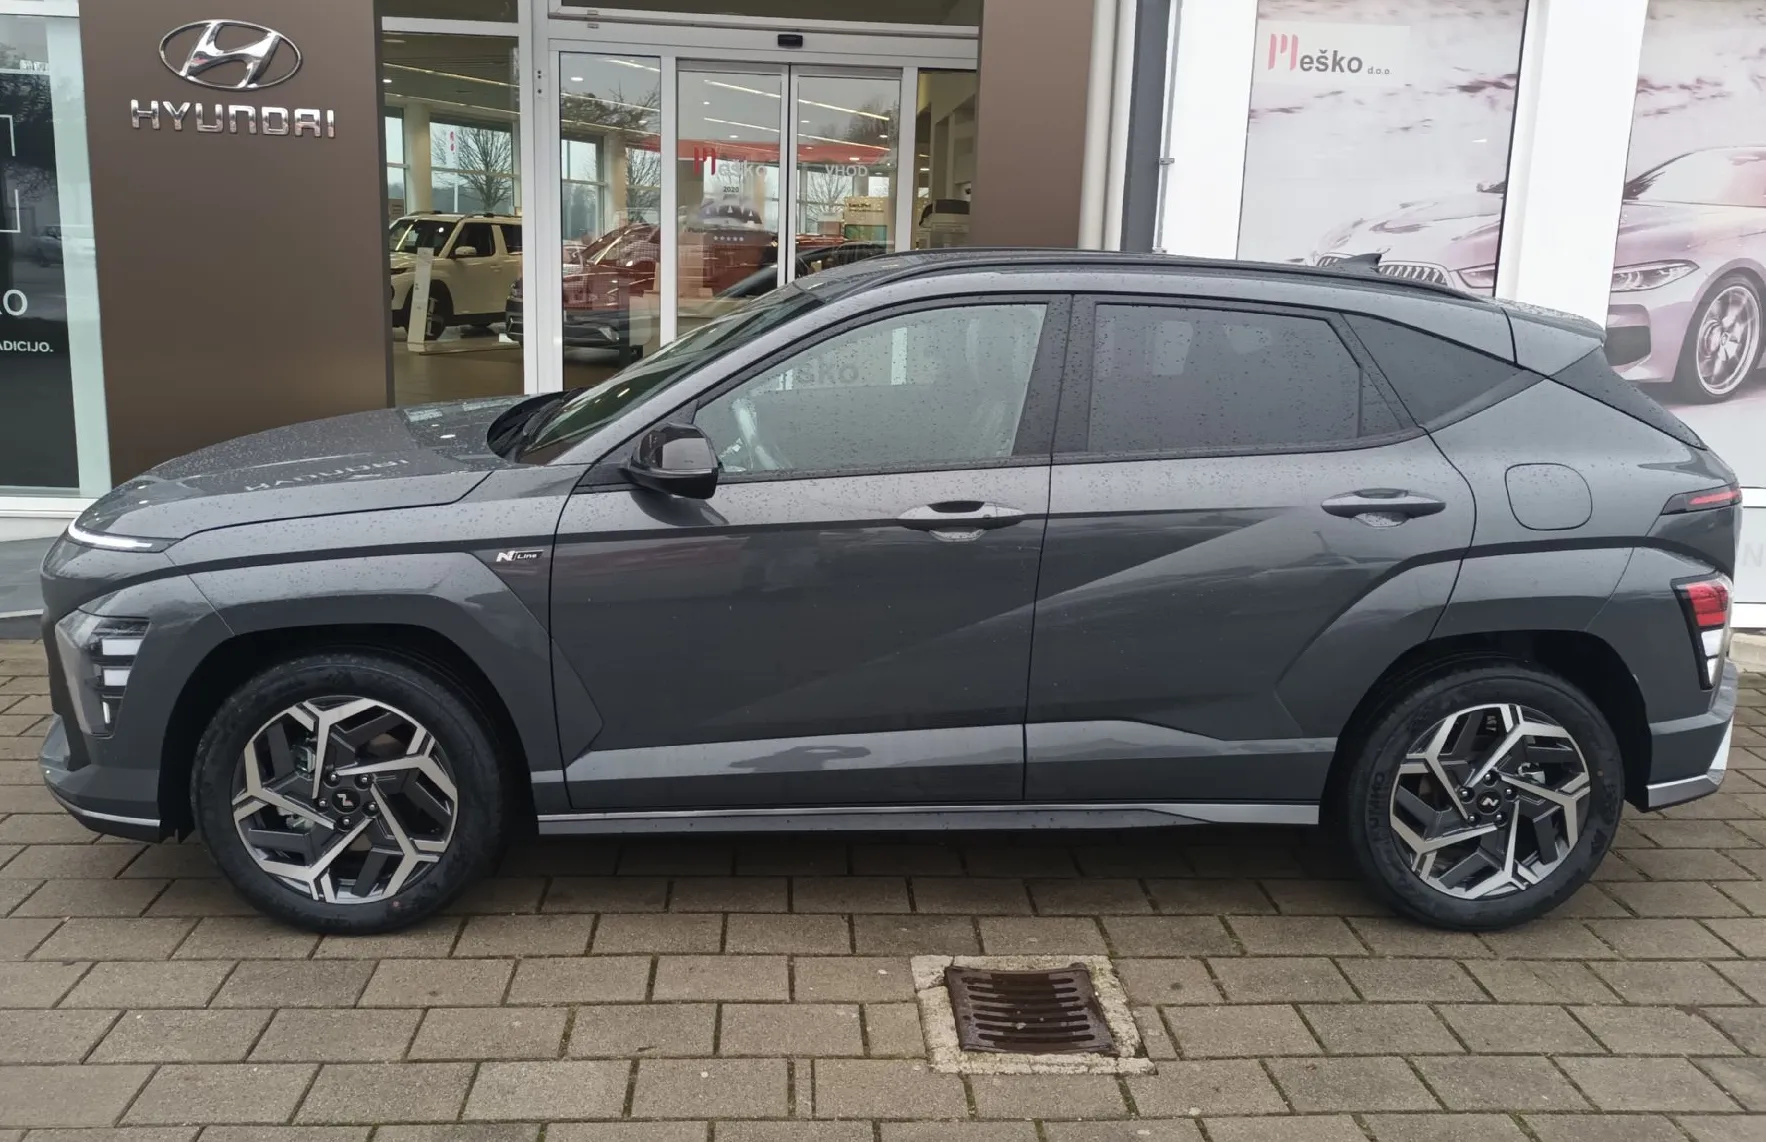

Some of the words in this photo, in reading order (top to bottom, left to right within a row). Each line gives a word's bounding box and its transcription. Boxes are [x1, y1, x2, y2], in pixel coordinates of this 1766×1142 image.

[1268, 33, 1363, 74] Meško
[130, 99, 335, 138] HYUNDAI
[825, 164, 868, 177] VHOD
